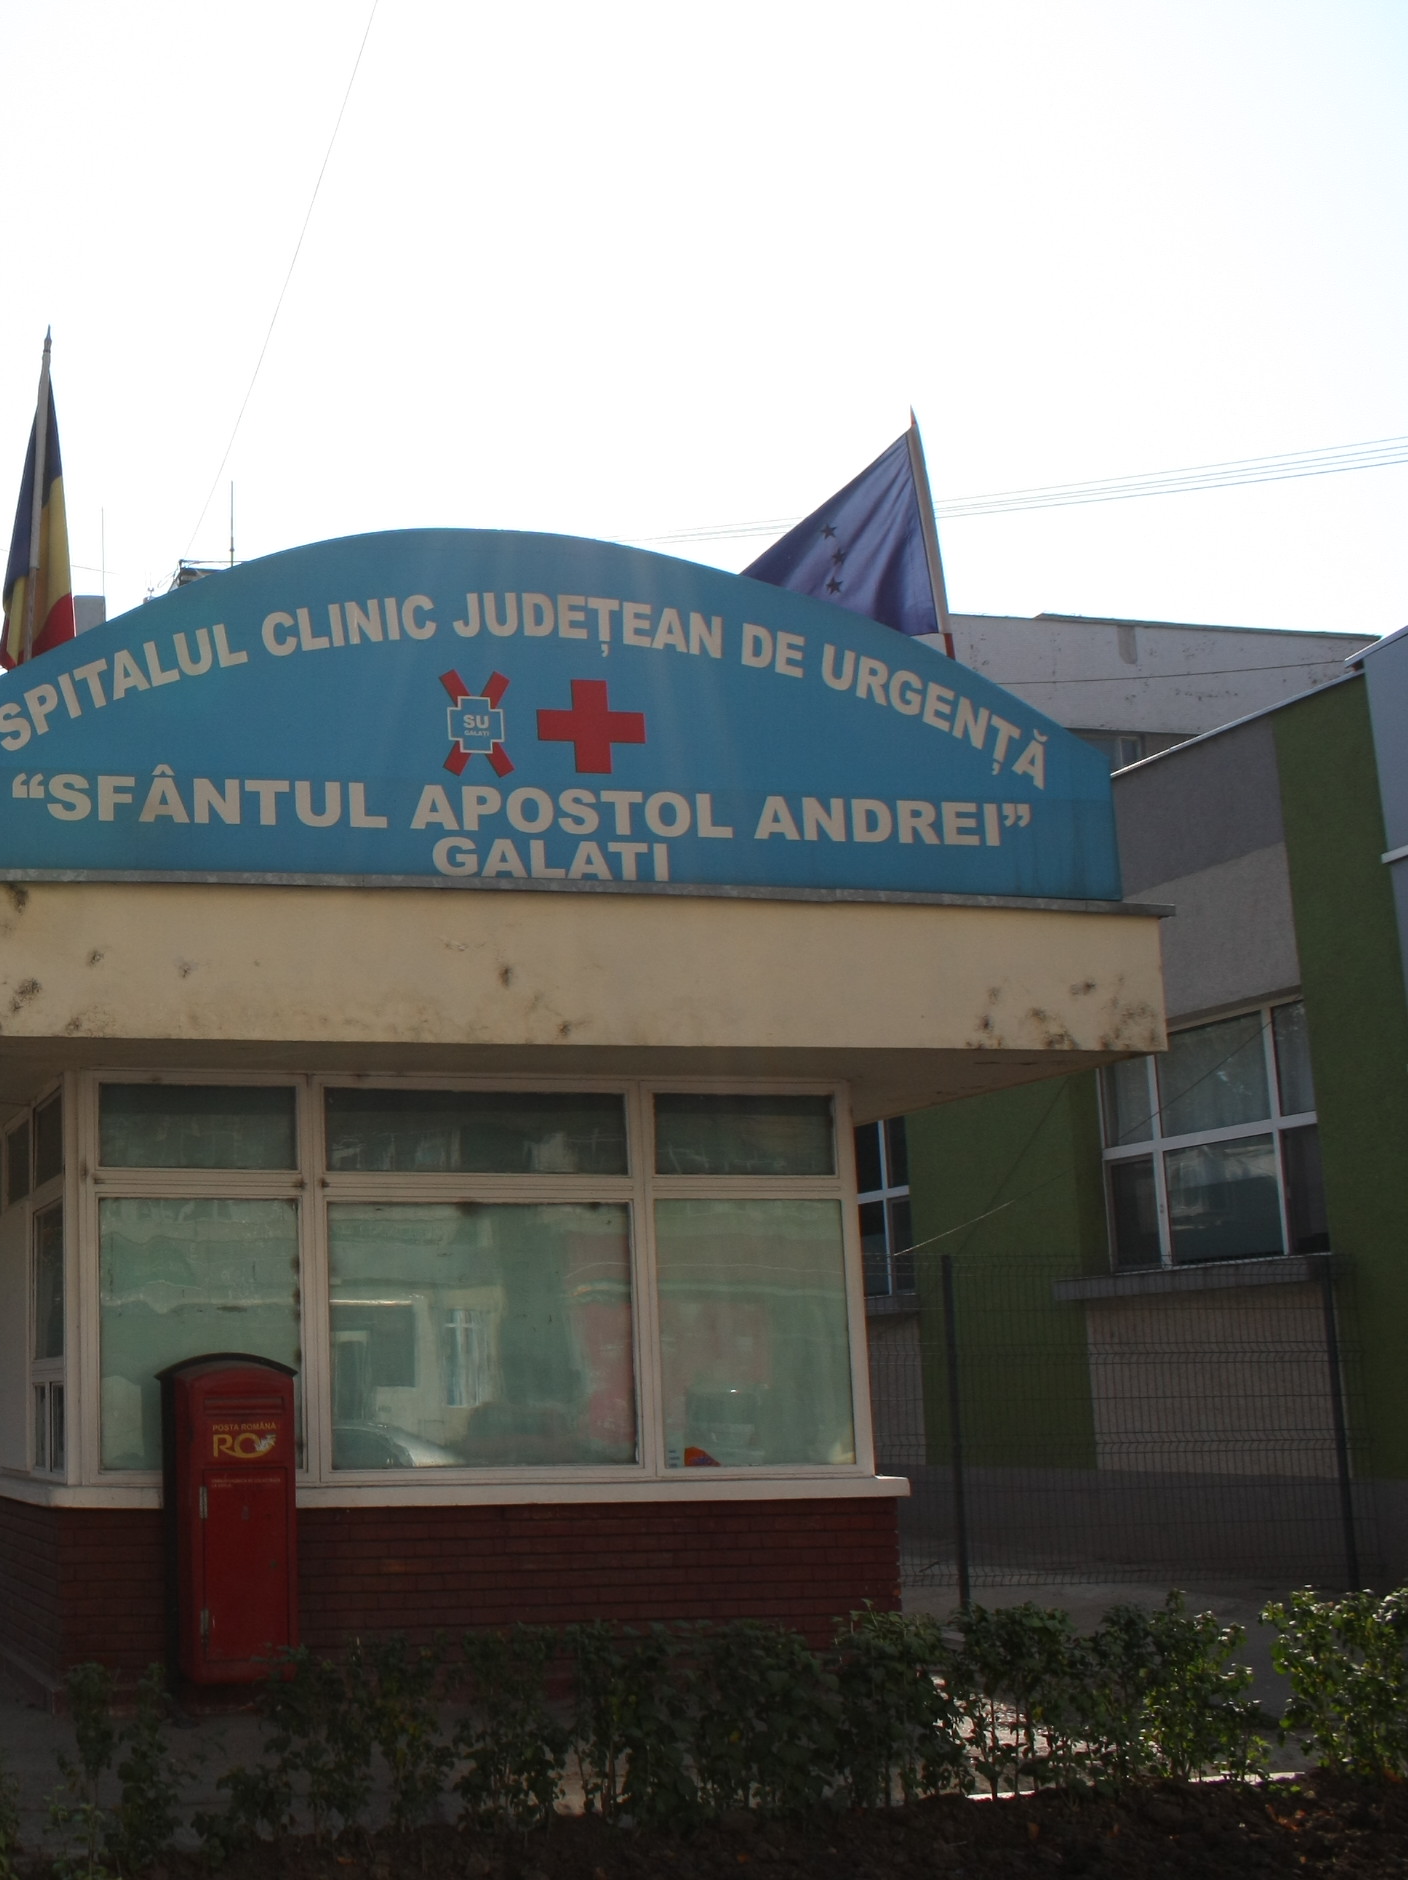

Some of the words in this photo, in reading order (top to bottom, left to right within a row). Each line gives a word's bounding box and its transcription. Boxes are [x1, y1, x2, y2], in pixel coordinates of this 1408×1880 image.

[261, 595, 437, 657] CLINIC
[453, 591, 723, 658] JUDEȚEAN
[741, 622, 806, 678] DE
[821, 644, 1048, 790] URGENȚĂ
[463, 714, 490, 729] SU
[12, 764, 388, 830] “SFÂNTUL
[410, 784, 733, 838] APOSTOL
[753, 796, 1032, 847] ANDREI”
